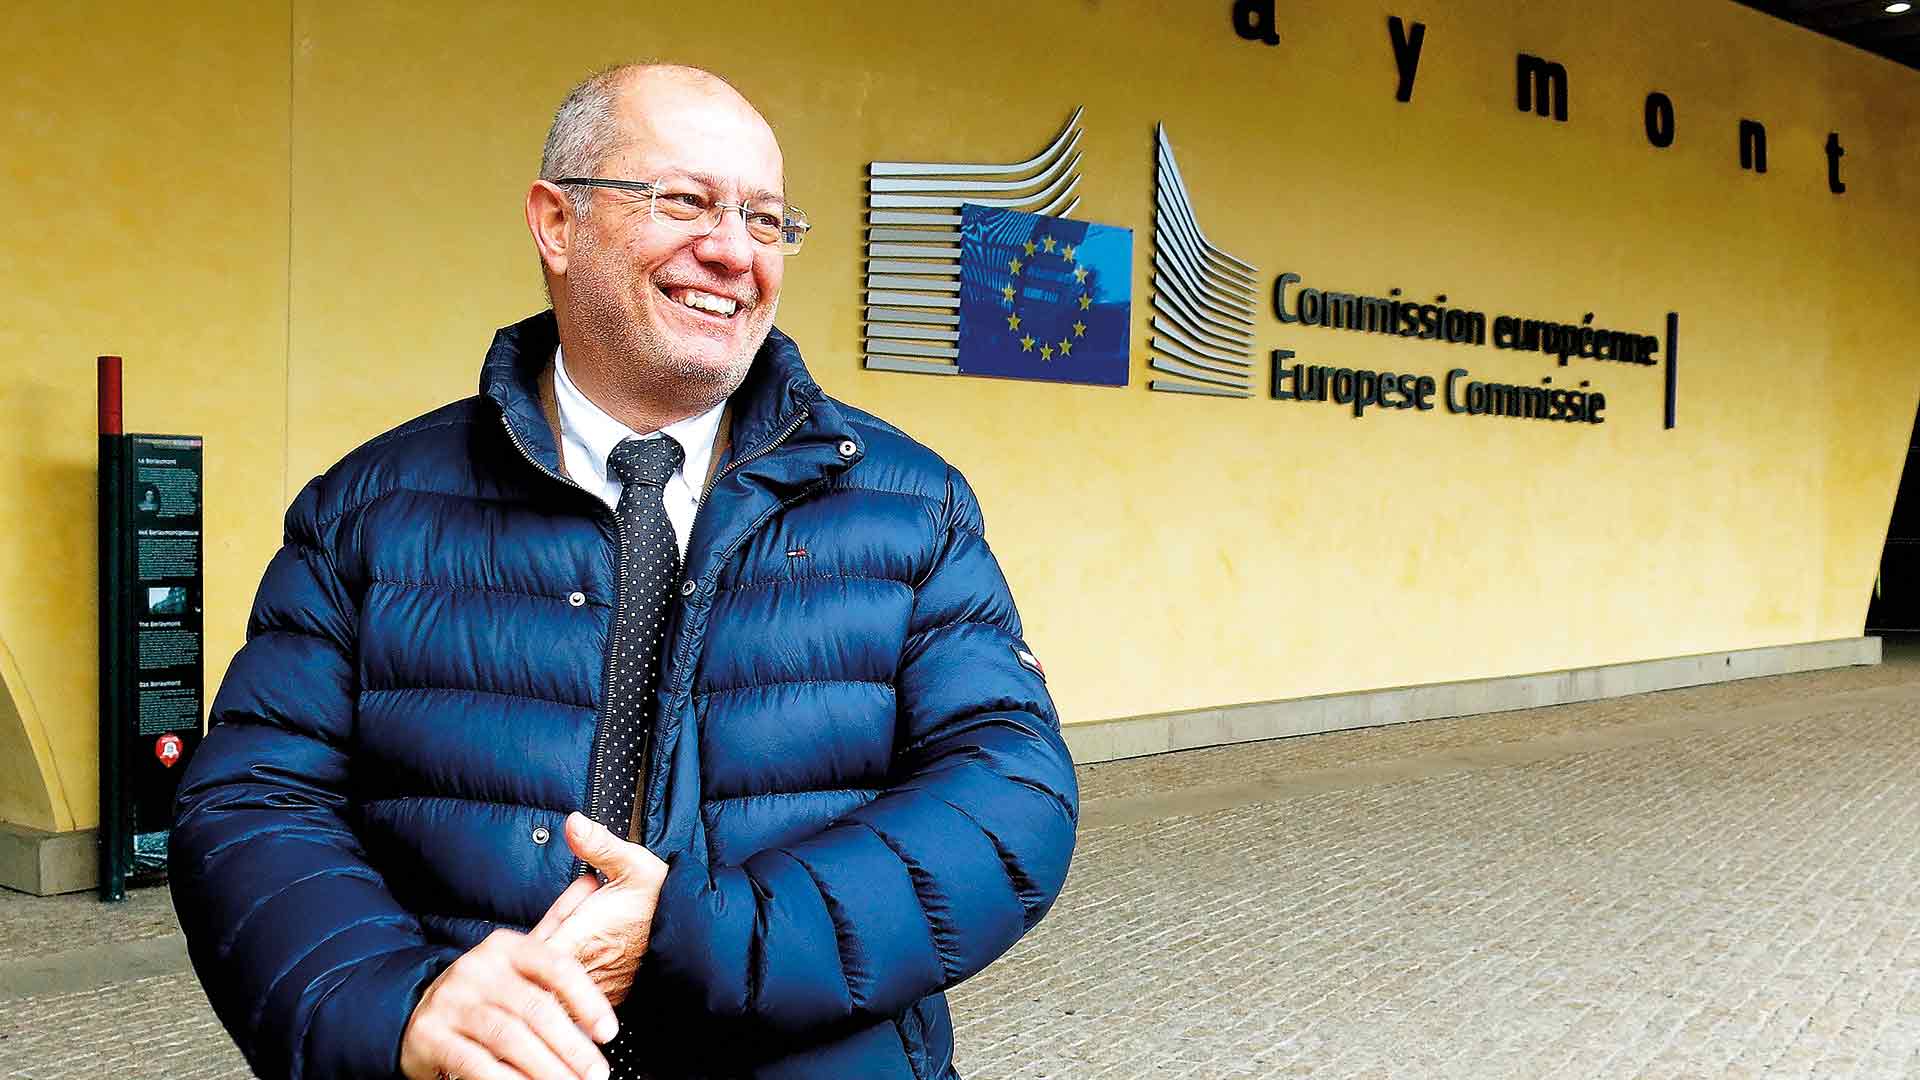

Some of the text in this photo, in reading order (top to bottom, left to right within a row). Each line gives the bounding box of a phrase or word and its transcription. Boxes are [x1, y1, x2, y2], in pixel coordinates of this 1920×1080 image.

[1273, 272, 1660, 367] Commission européenne
[1270, 349, 1607, 425] Europese Commissie
